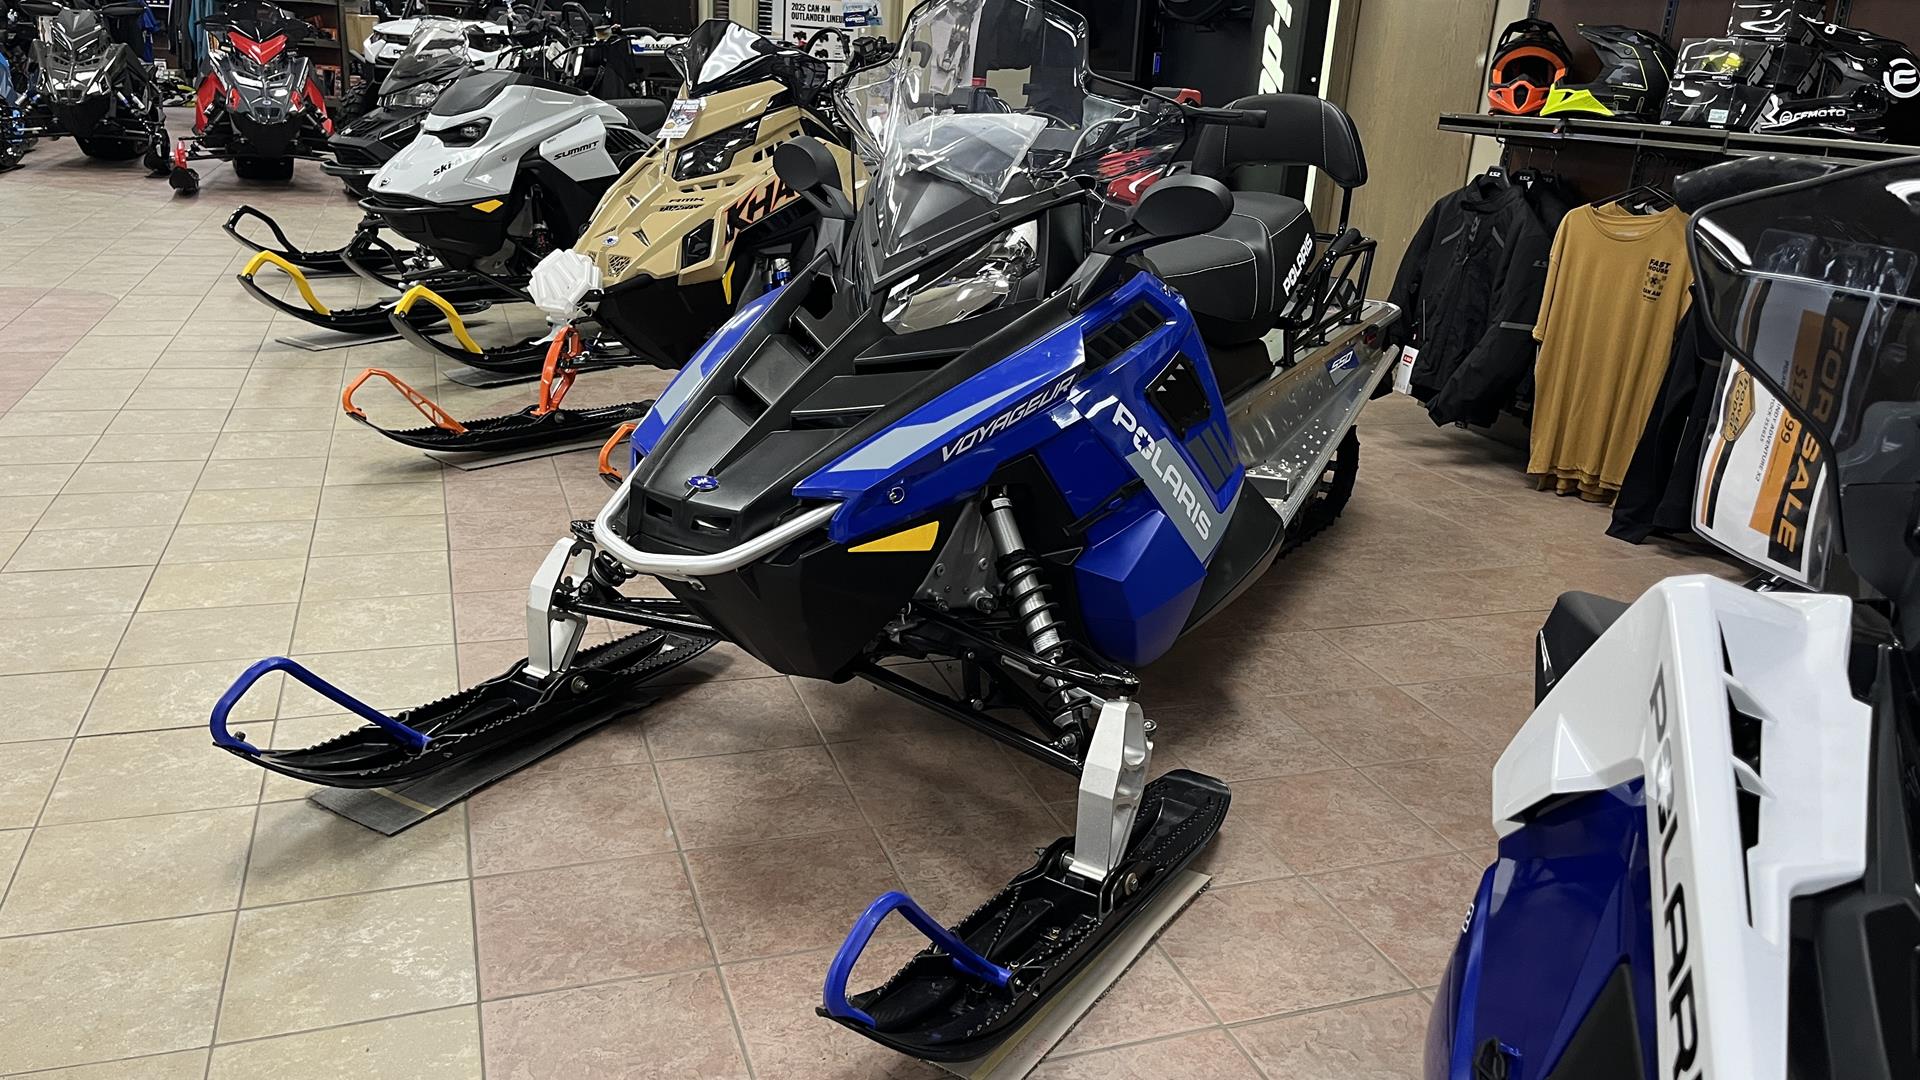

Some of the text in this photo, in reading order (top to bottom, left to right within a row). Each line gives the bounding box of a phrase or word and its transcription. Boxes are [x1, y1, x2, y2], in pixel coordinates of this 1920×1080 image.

[791, 3, 806, 11] 2025
[791, 12, 846, 23] OUTLANDER LINEU
[1793, 108, 1847, 121] CFMOTO
[553, 140, 600, 161] SUMMIT
[723, 177, 797, 247] KHA
[1282, 232, 1314, 296] POLARIS
[1648, 265, 1669, 274] HOUSE
[1649, 258, 1671, 269] FAST
[1812, 316, 1850, 424] FOR
[941, 373, 1077, 463] VOYAGEUR
[1733, 377, 1750, 436] POWER
[1112, 401, 1212, 541] POLARIS
[1758, 422, 1776, 470] ADVENTURE
[1776, 431, 1821, 553] SALE
